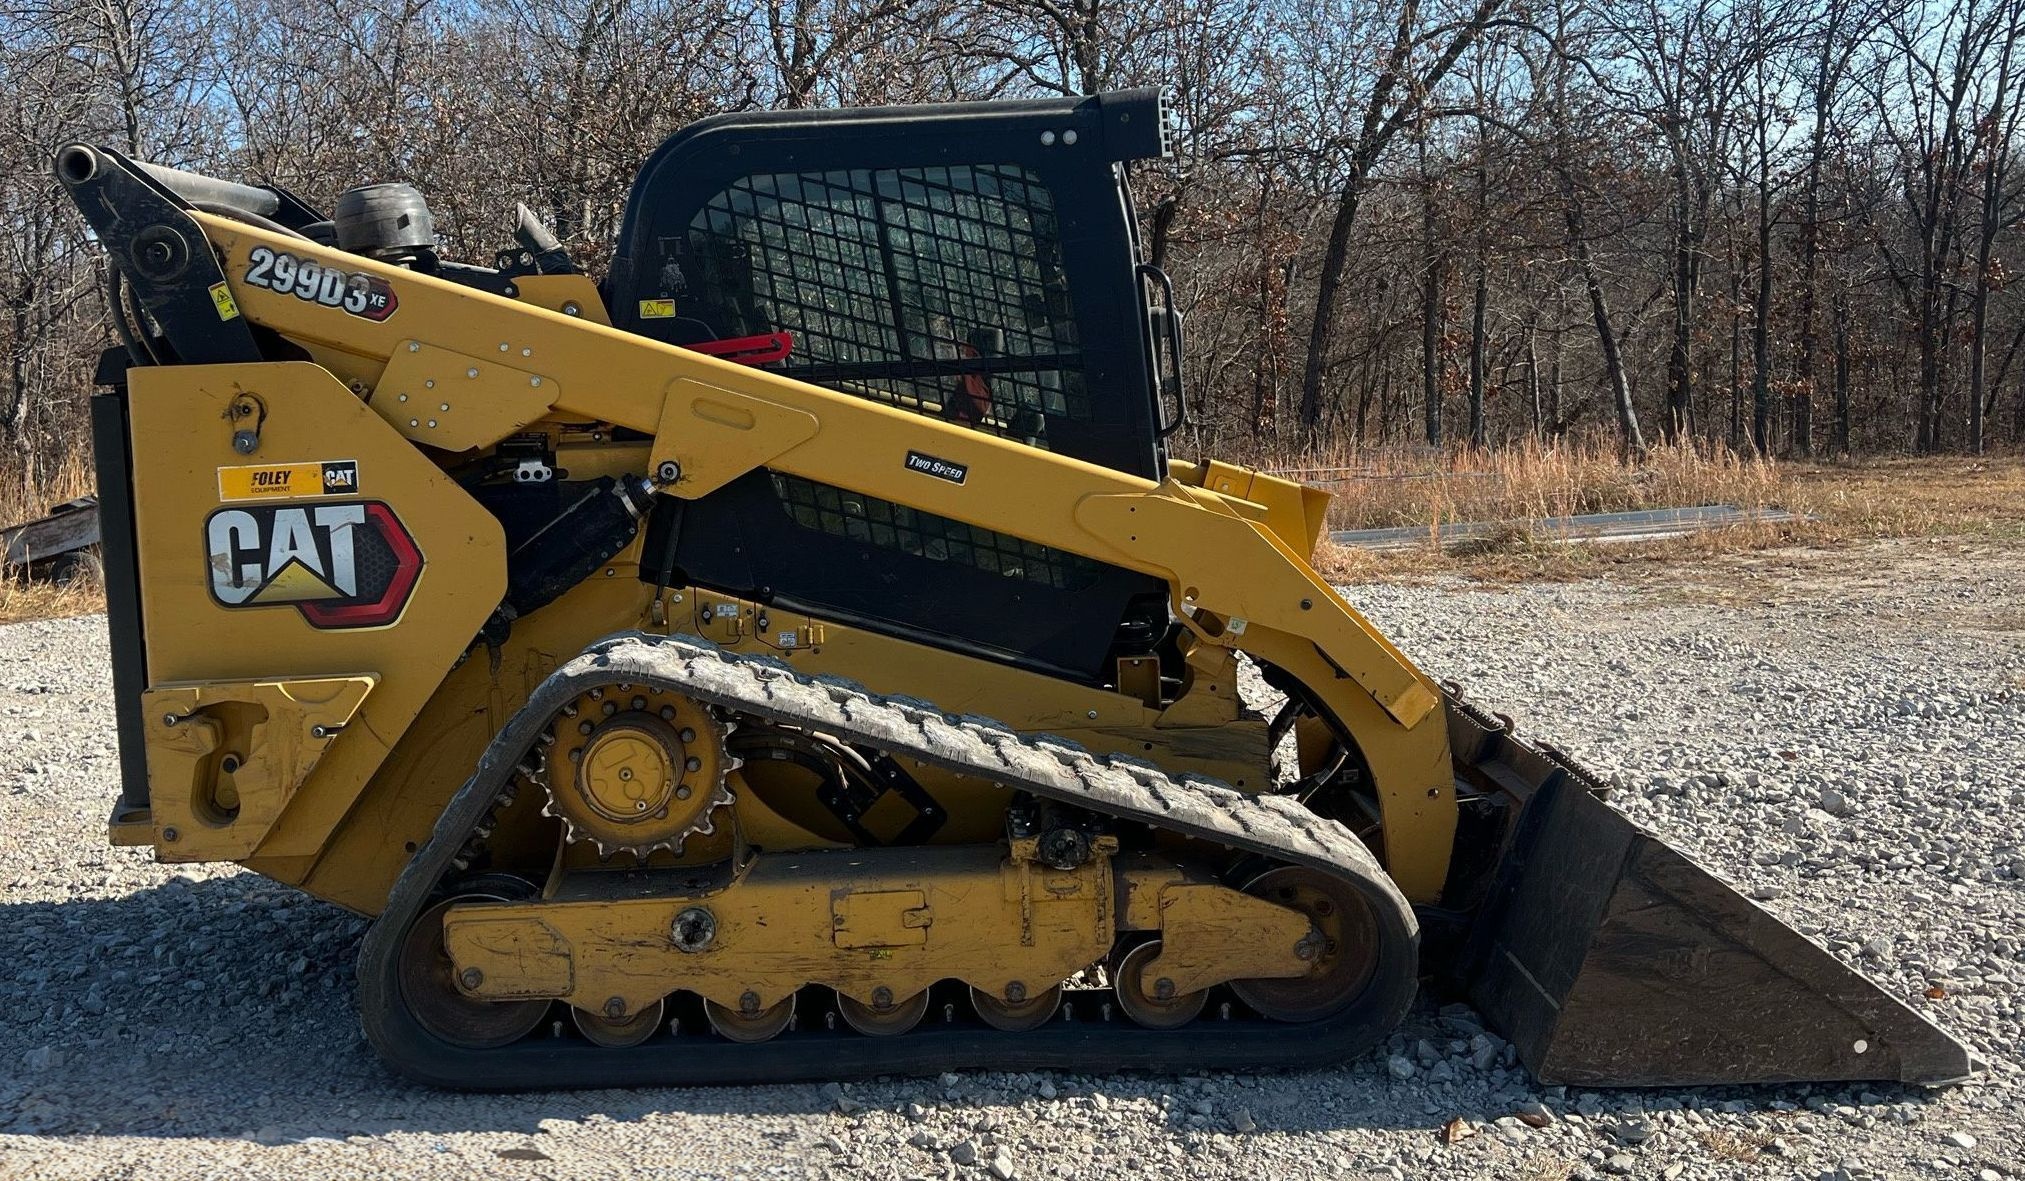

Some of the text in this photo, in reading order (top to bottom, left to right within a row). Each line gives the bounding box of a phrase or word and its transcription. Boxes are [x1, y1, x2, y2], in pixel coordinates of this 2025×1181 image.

[245, 247, 386, 313] 299D3 XE
[908, 455, 931, 470] TWO
[251, 470, 292, 486] FOLEY
[324, 468, 354, 488] CAT
[208, 504, 366, 604] CAT
